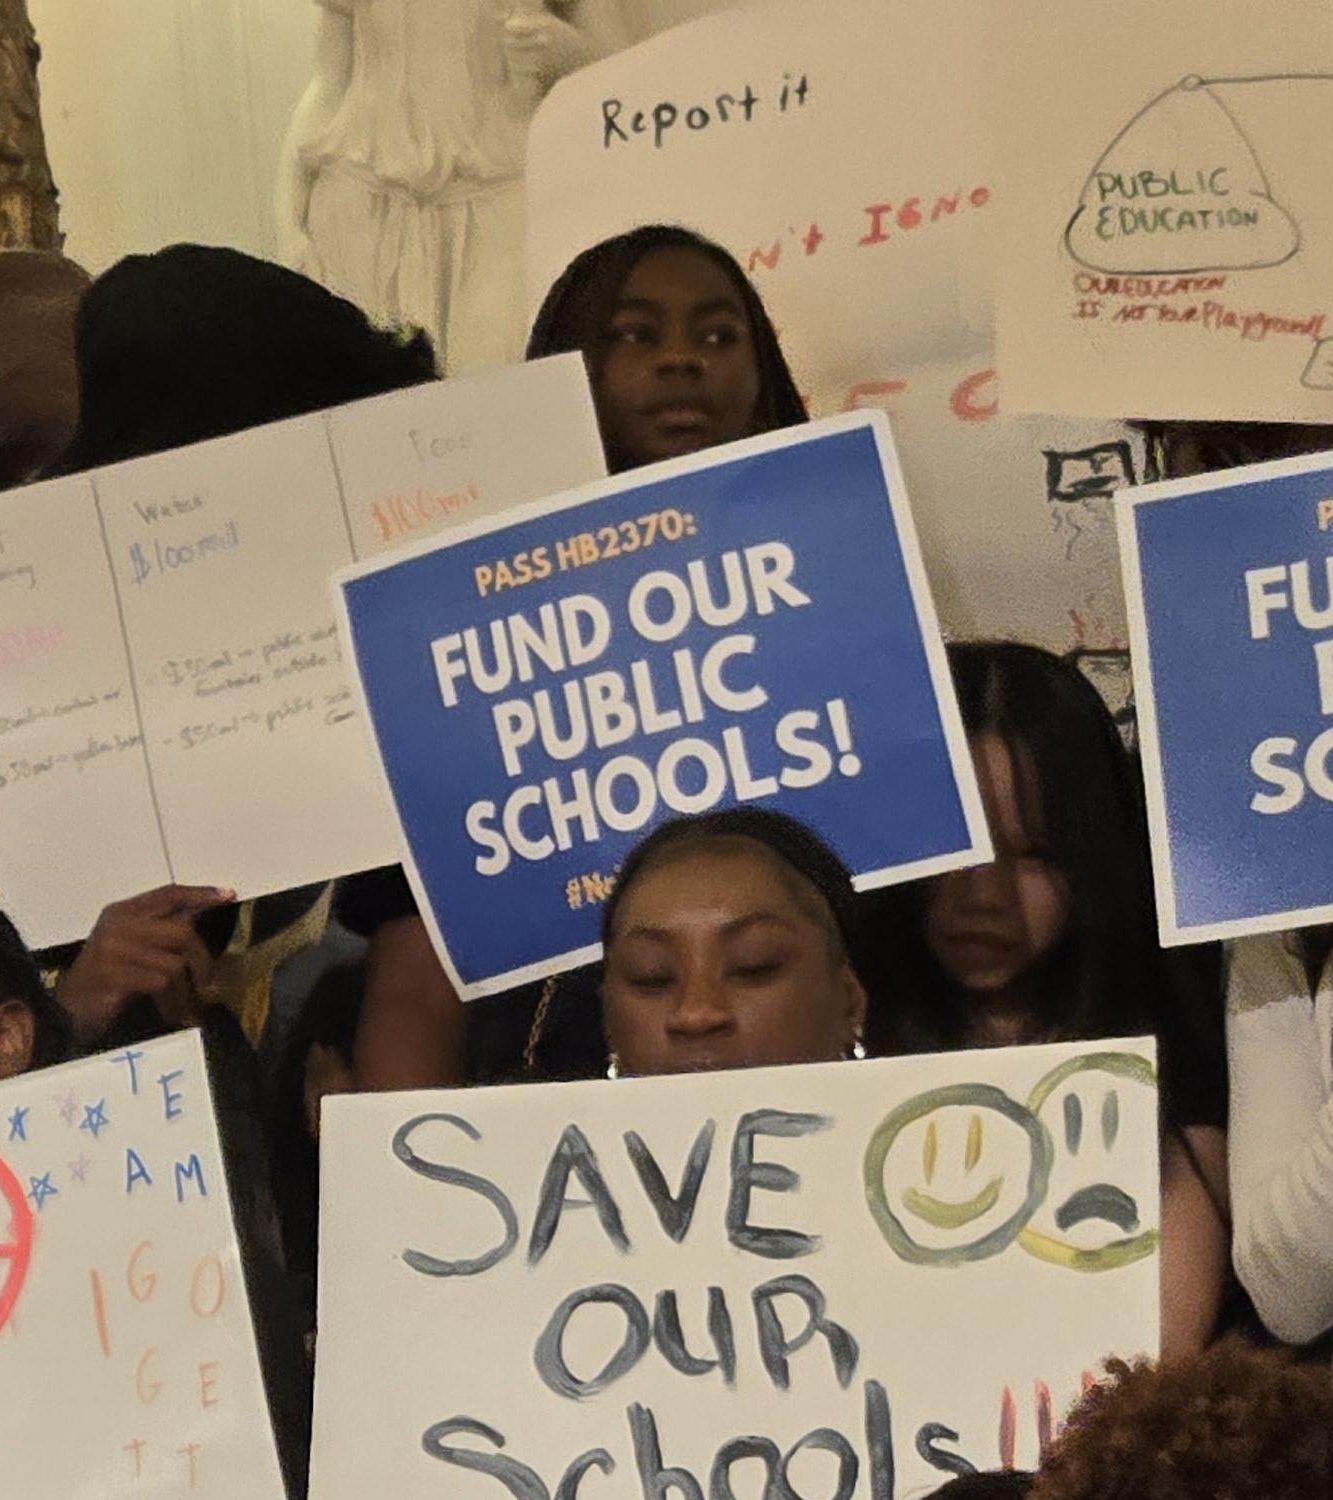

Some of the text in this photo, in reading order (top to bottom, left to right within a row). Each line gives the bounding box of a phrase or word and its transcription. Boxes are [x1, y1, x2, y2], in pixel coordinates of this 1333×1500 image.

[601, 72, 809, 149] Report it
[1095, 205, 1258, 241] EDUCATION
[1096, 166, 1229, 202] PUBLIC
[474, 508, 698, 598] PASS HB2370:
[431, 541, 812, 708] FUND OUR
[492, 634, 769, 778] PUBLIC
[465, 698, 861, 876] SCHOOLS!
[389, 1108, 836, 1278] SAVE
